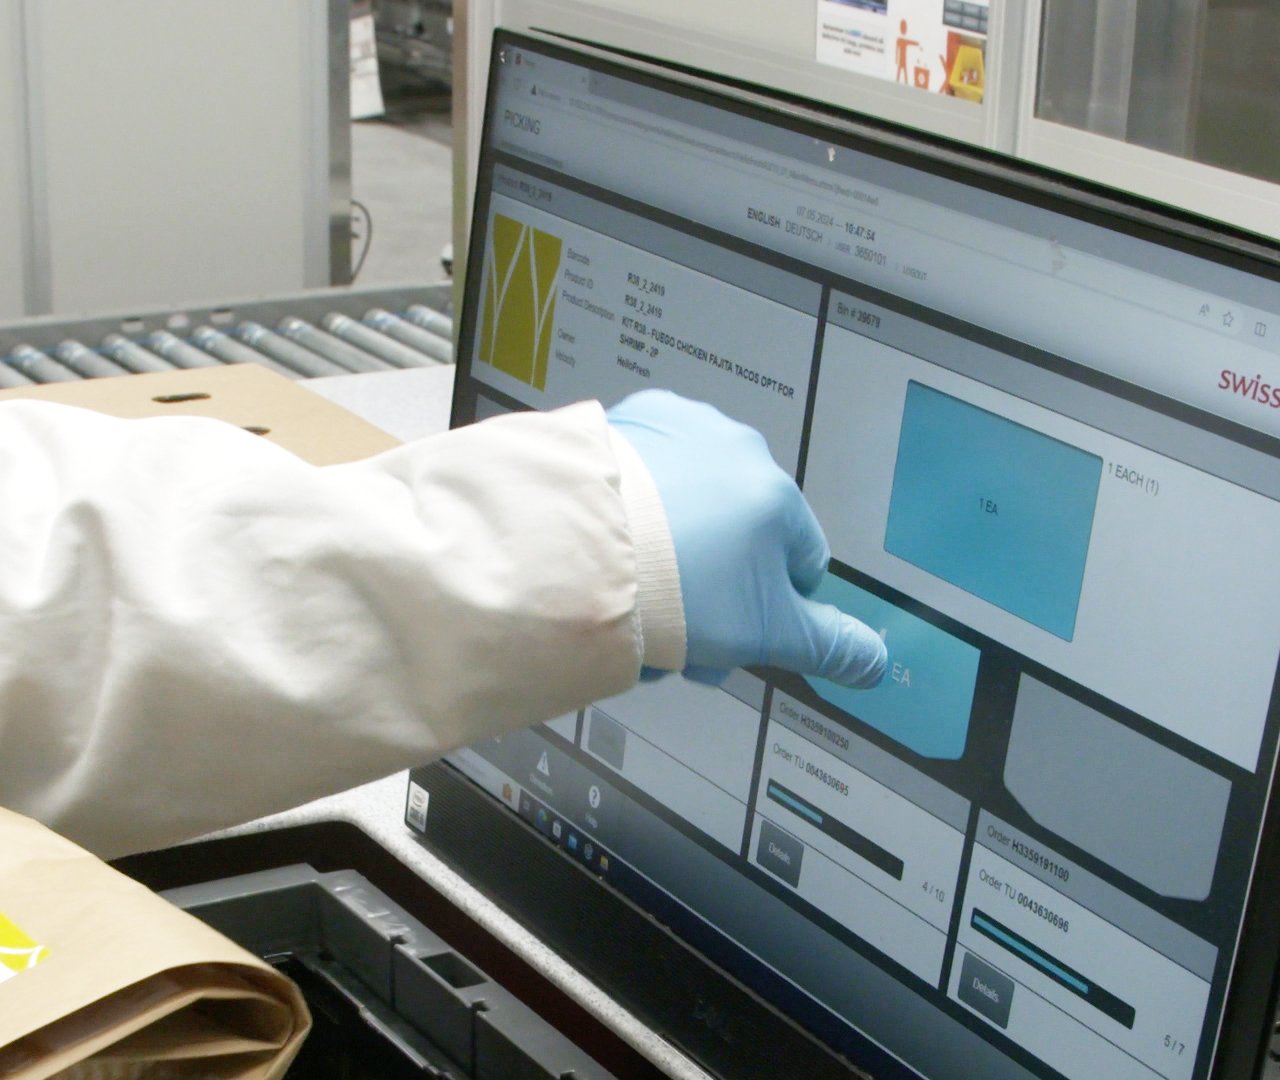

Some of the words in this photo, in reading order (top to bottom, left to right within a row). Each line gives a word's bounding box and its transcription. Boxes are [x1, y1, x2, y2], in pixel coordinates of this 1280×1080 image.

[504, 109, 541, 136] PICKING
[747, 207, 782, 228] ENGLISH
[785, 220, 823, 243] DEUTSCH
[619, 333, 646, 353] SHRIMP
[650, 328, 676, 348] FUEGO
[676, 339, 709, 362] CHICKEN
[708, 353, 734, 373] FAJITA
[734, 364, 760, 385] TACOS
[760, 375, 778, 391] OPT
[778, 382, 795, 399] FOR
[1115, 464, 1145, 489] EACH
[1145, 478, 1160, 497] (1)
[985, 500, 999, 516] EA
[891, 661, 912, 688] EA
[773, 742, 793, 762] Order
[794, 754, 805, 770] TU
[986, 824, 1011, 847] Order
[935, 888, 945, 904] 10
[979, 868, 1003, 890] Order
[1004, 882, 1017, 900] TU
[1017, 891, 1070, 933] 0043630696
